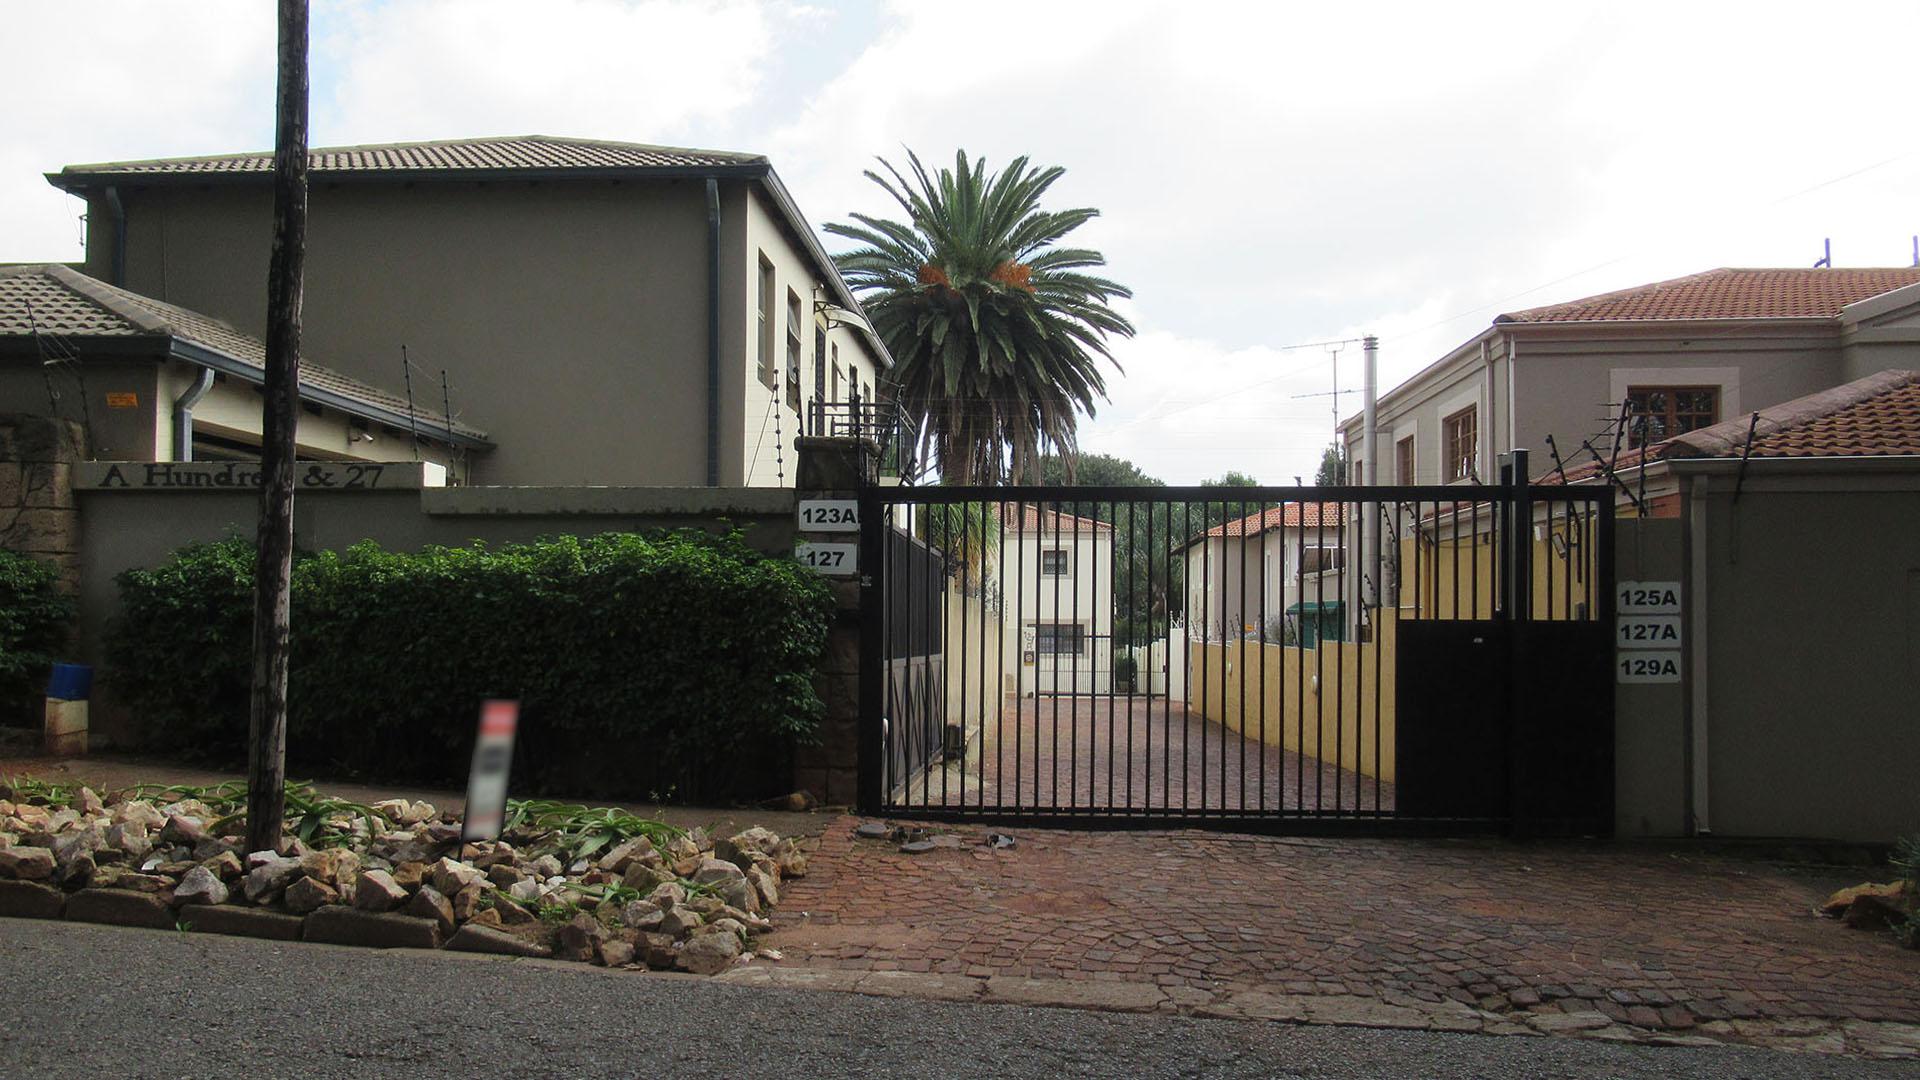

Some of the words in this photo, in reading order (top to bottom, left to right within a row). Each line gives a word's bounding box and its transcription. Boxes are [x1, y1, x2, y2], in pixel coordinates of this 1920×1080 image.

[98, 463, 130, 487] A
[143, 463, 263, 487] Hundre
[303, 465, 338, 486] &
[343, 464, 384, 488] 27
[802, 507, 857, 524] 123A
[807, 550, 845, 567] 127
[1620, 589, 1678, 606] 125A
[1620, 623, 1678, 640] 127A
[1620, 659, 1678, 676] 129A
